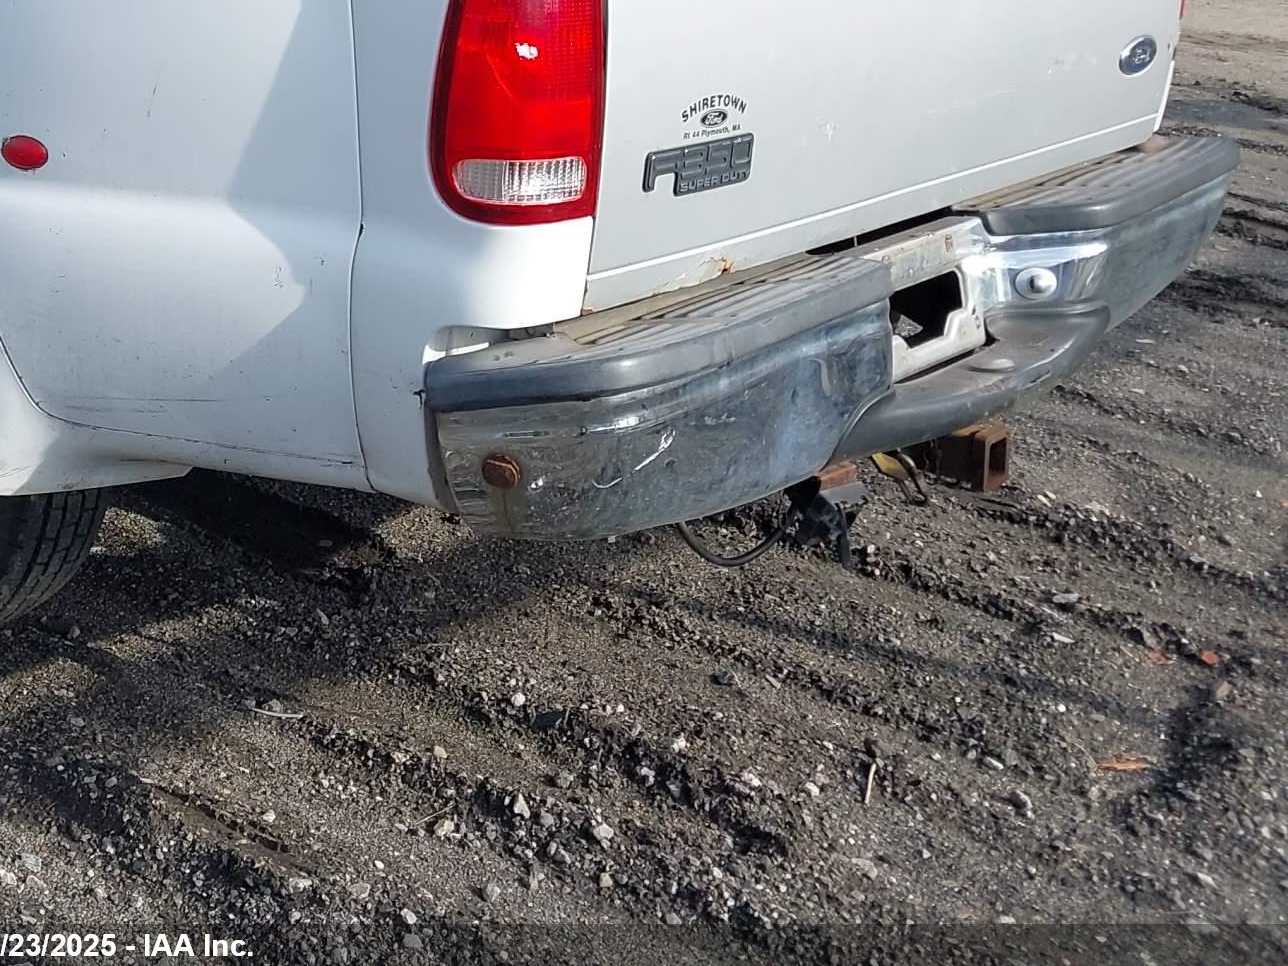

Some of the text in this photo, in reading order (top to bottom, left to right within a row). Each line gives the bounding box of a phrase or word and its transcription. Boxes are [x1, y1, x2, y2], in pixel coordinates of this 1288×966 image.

[681, 94, 747, 123] SHIRETOWN
[692, 130, 700, 139] 44
[732, 123, 741, 131] MA
[679, 169, 750, 192] SUPER DUTY
